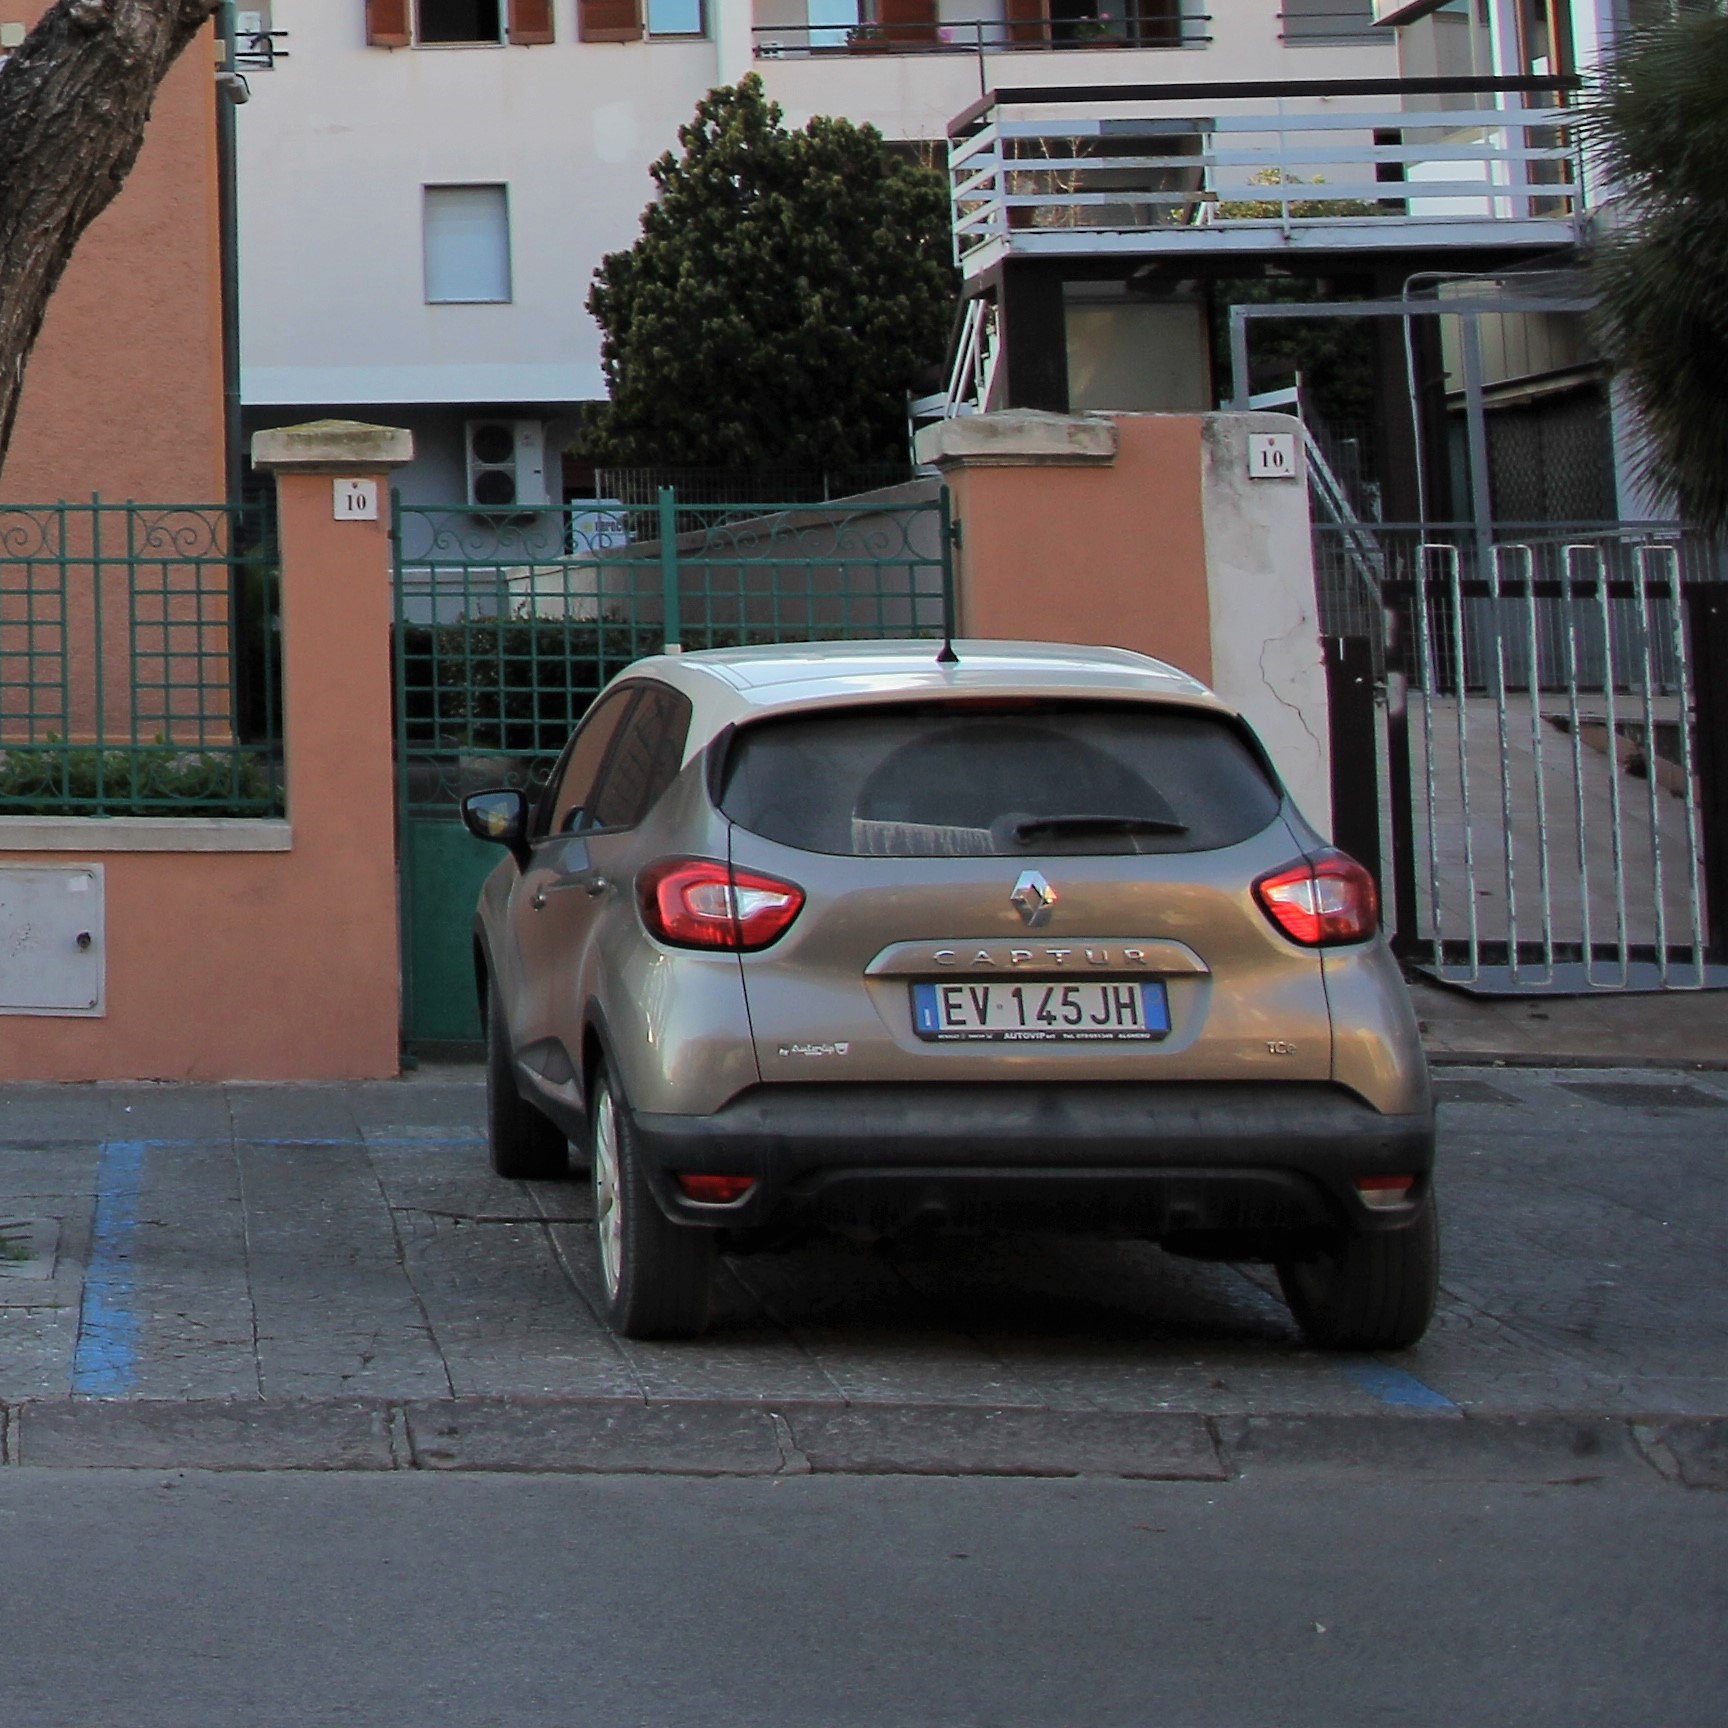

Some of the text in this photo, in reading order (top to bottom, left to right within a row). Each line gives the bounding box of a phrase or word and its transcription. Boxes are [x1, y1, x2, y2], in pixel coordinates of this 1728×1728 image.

[1262, 450, 1283, 468] 10
[347, 494, 366, 511] 10
[933, 948, 1147, 966] CAPTUR
[943, 986, 1139, 1026] EV 145JH
